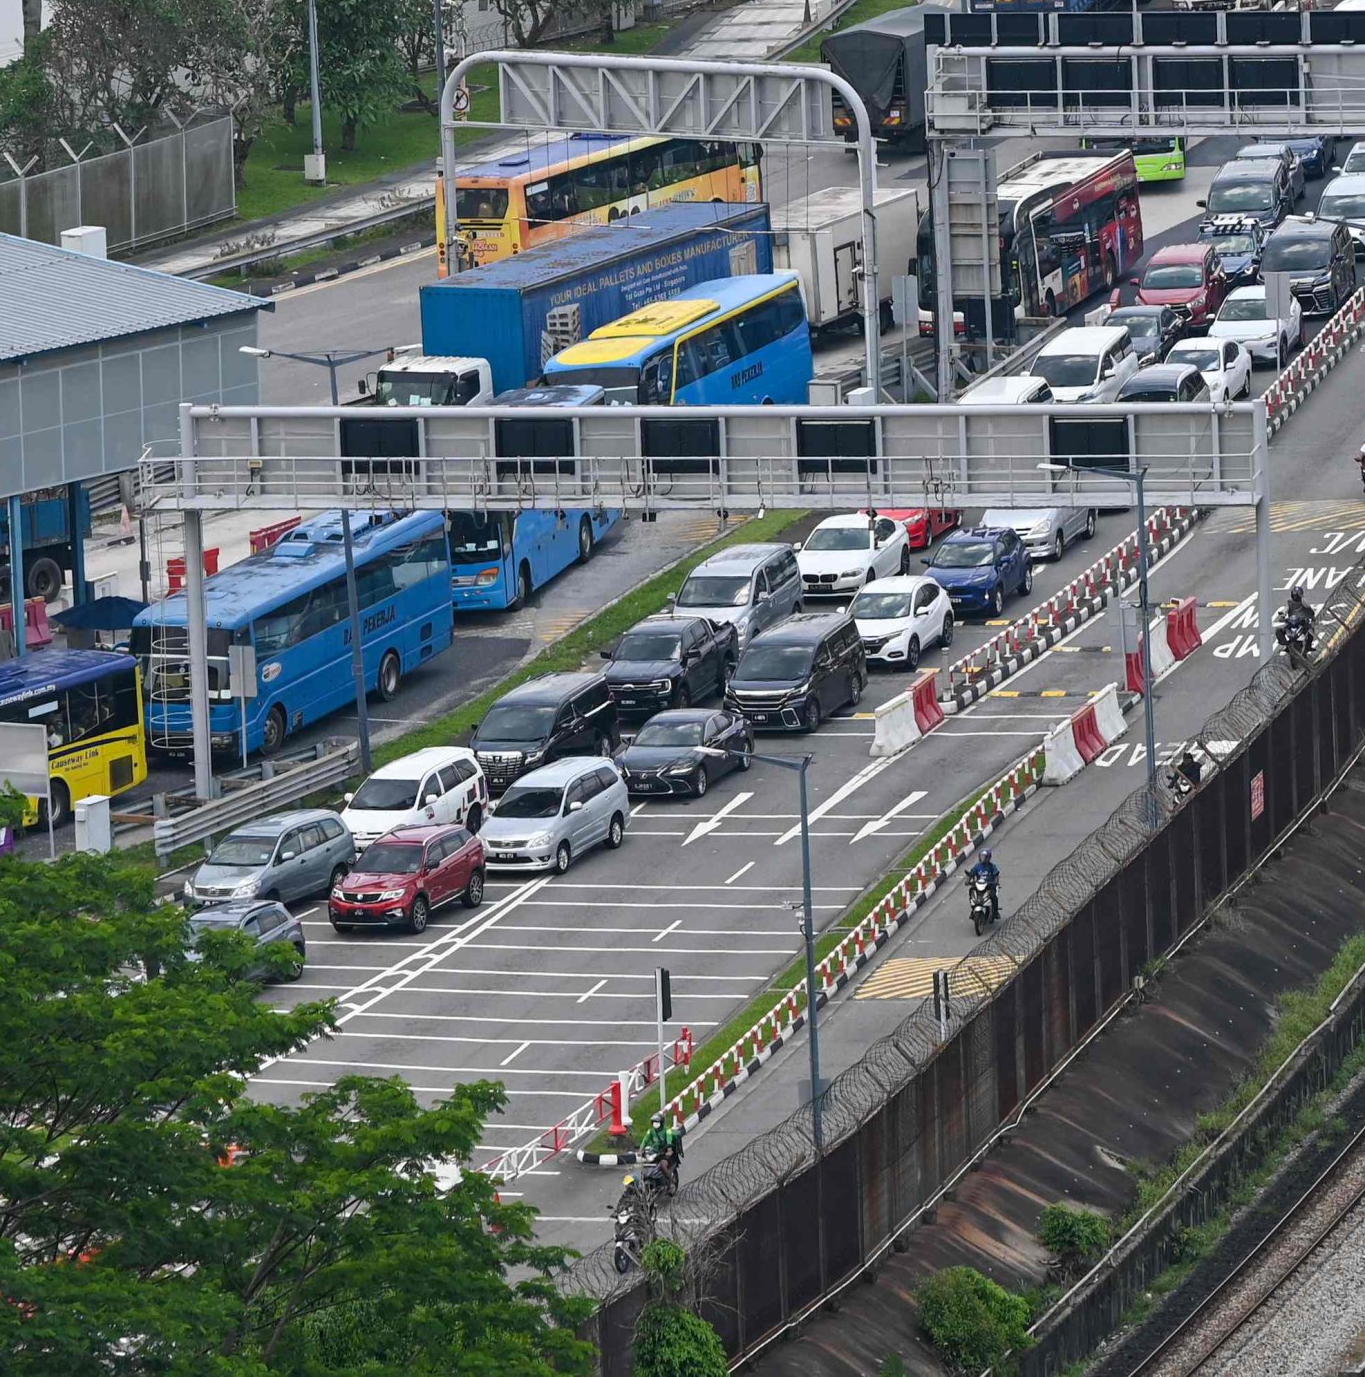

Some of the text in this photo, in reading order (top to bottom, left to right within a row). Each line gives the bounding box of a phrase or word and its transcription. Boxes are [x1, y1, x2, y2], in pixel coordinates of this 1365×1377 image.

[549, 231, 751, 306] YOUR IDEAL PALLETS AND BOXES MANUFACTURER
[363, 604, 395, 636] PEKERJA
[51, 753, 83, 771] Causeway
[84, 747, 100, 763] Link
